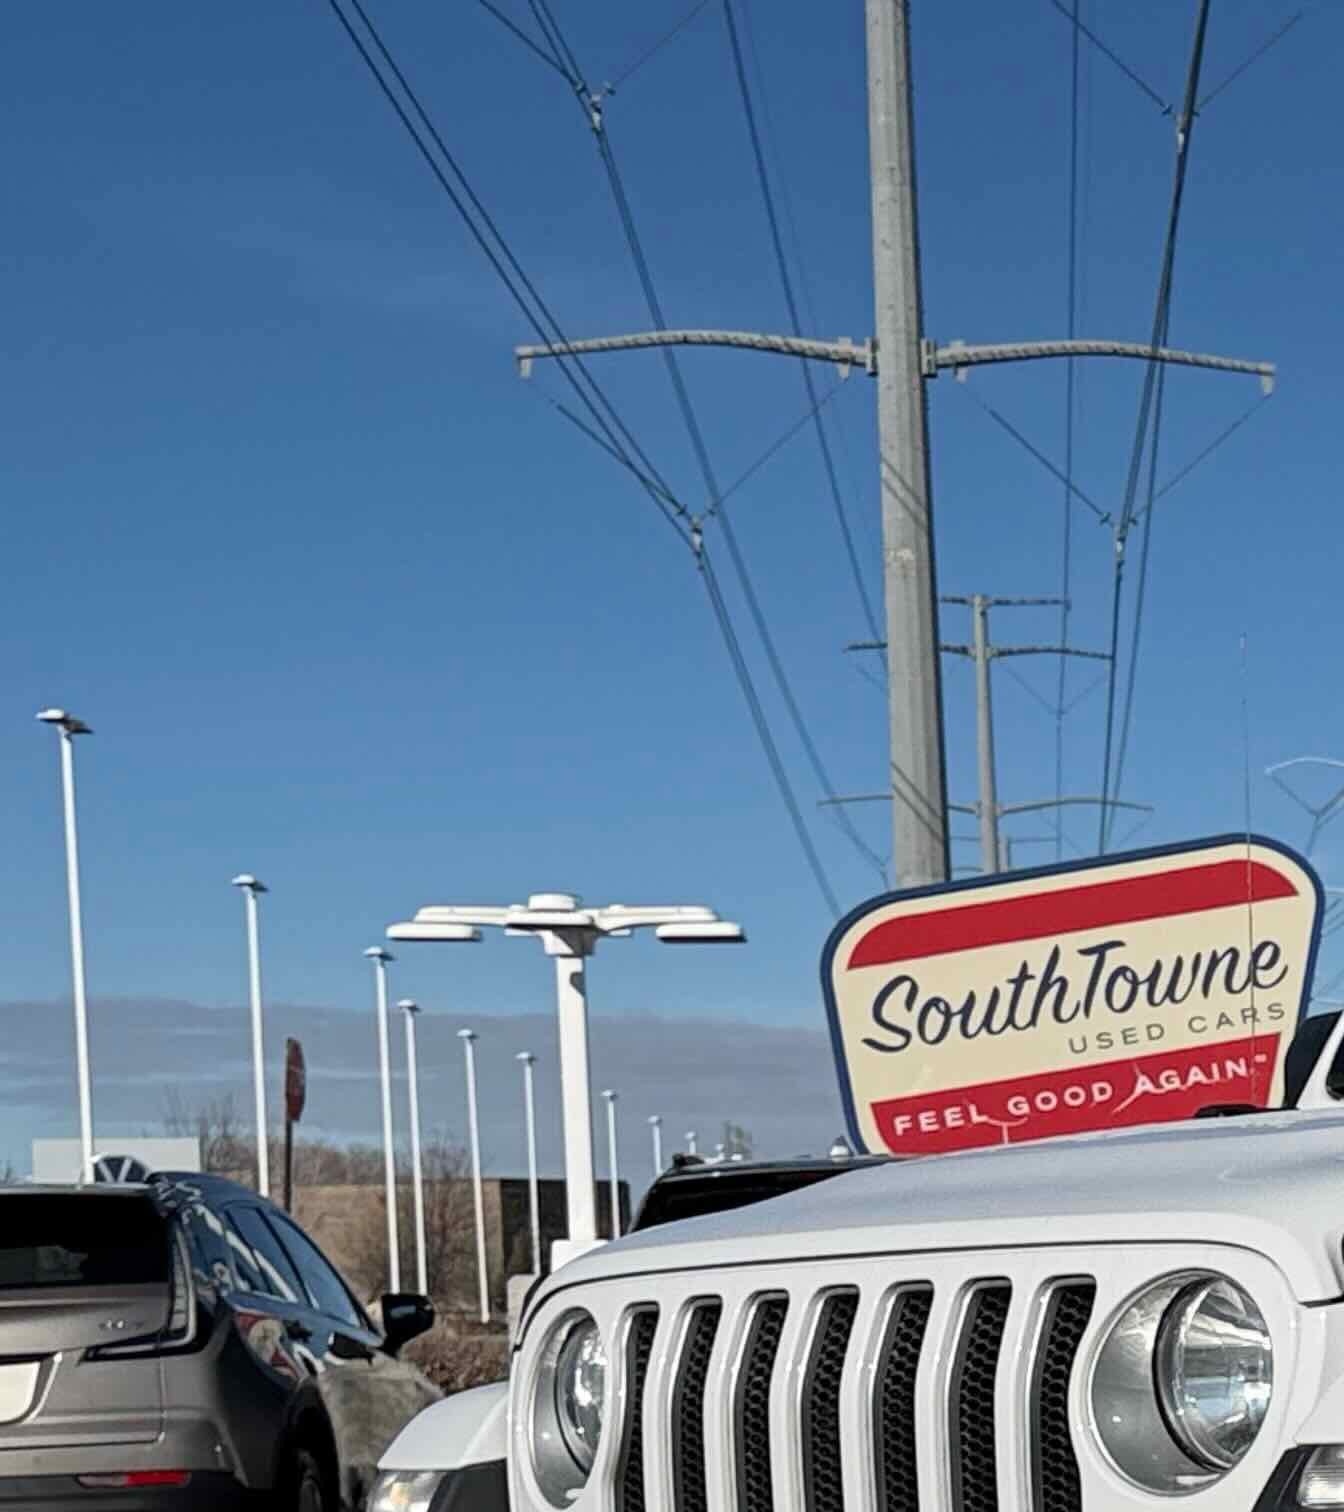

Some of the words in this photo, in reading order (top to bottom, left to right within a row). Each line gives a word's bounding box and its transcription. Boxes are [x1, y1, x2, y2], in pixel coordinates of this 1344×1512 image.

[861, 939, 1288, 1053] SouthTowne
[1068, 1022, 1165, 1055] USED
[1187, 1002, 1285, 1034] CARS
[893, 1103, 988, 1136] FEEL
[1007, 1081, 1113, 1117] GOOD
